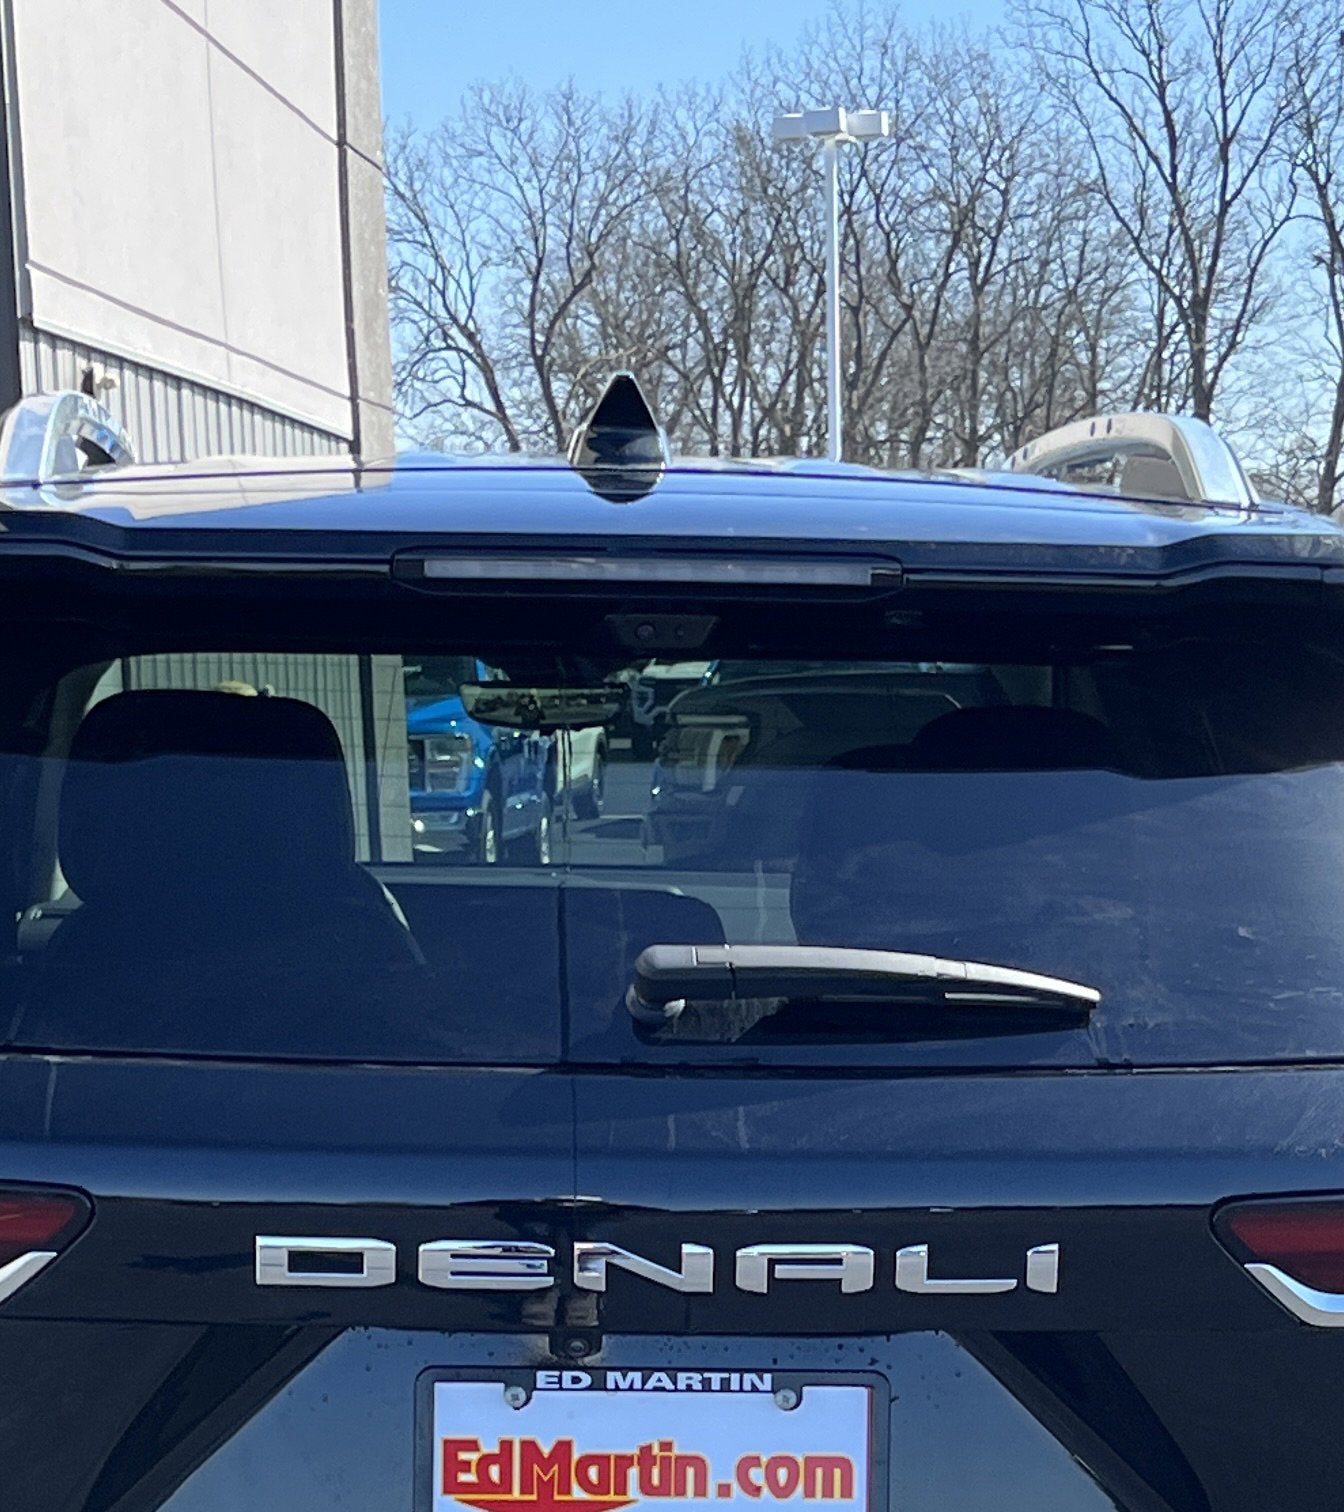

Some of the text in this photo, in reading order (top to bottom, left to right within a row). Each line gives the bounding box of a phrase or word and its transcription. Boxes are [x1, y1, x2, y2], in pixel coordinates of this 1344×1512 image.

[256, 1235, 1059, 1295] DENALI
[536, 1370, 772, 1392] ED MARTIN
